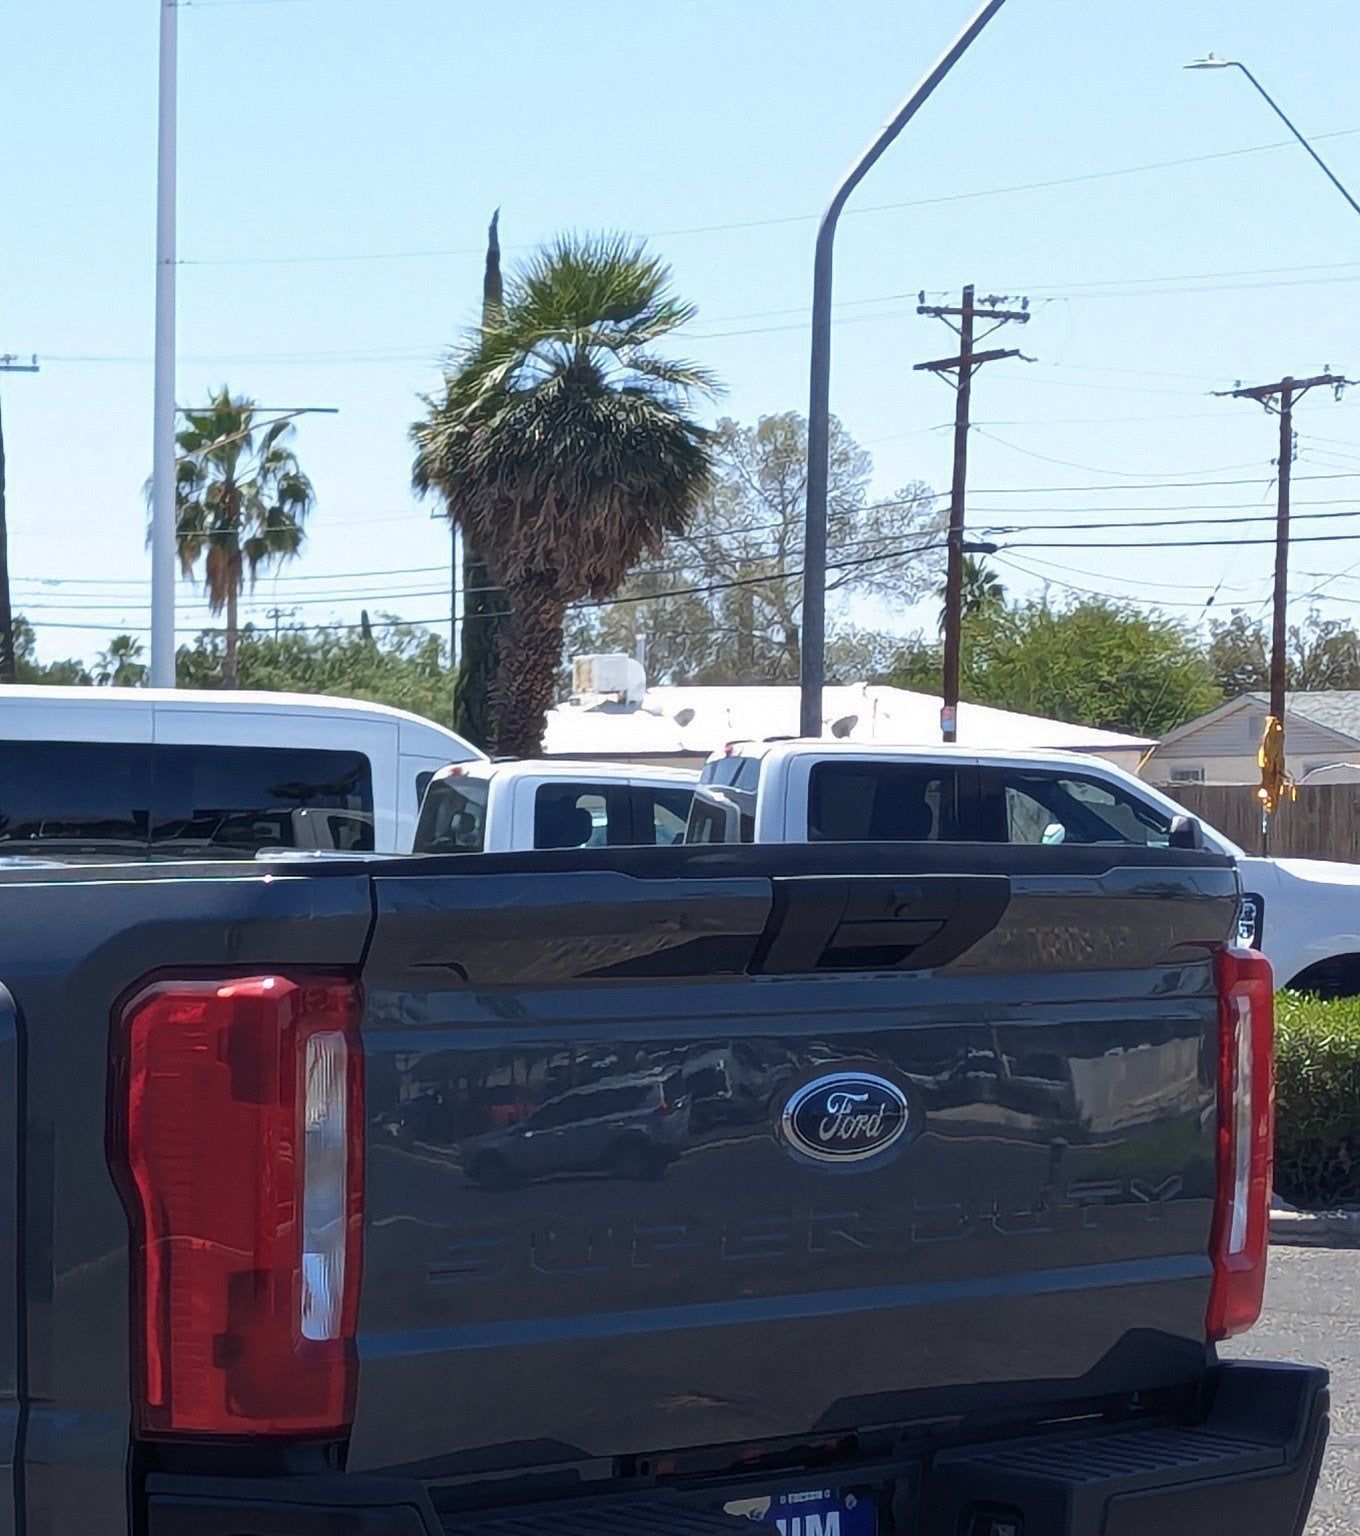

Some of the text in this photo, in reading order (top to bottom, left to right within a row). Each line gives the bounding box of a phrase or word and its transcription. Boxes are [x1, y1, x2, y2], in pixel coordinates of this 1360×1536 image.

[818, 1092, 886, 1141] Ford
[427, 1174, 1183, 1284] SUPER DUTY
